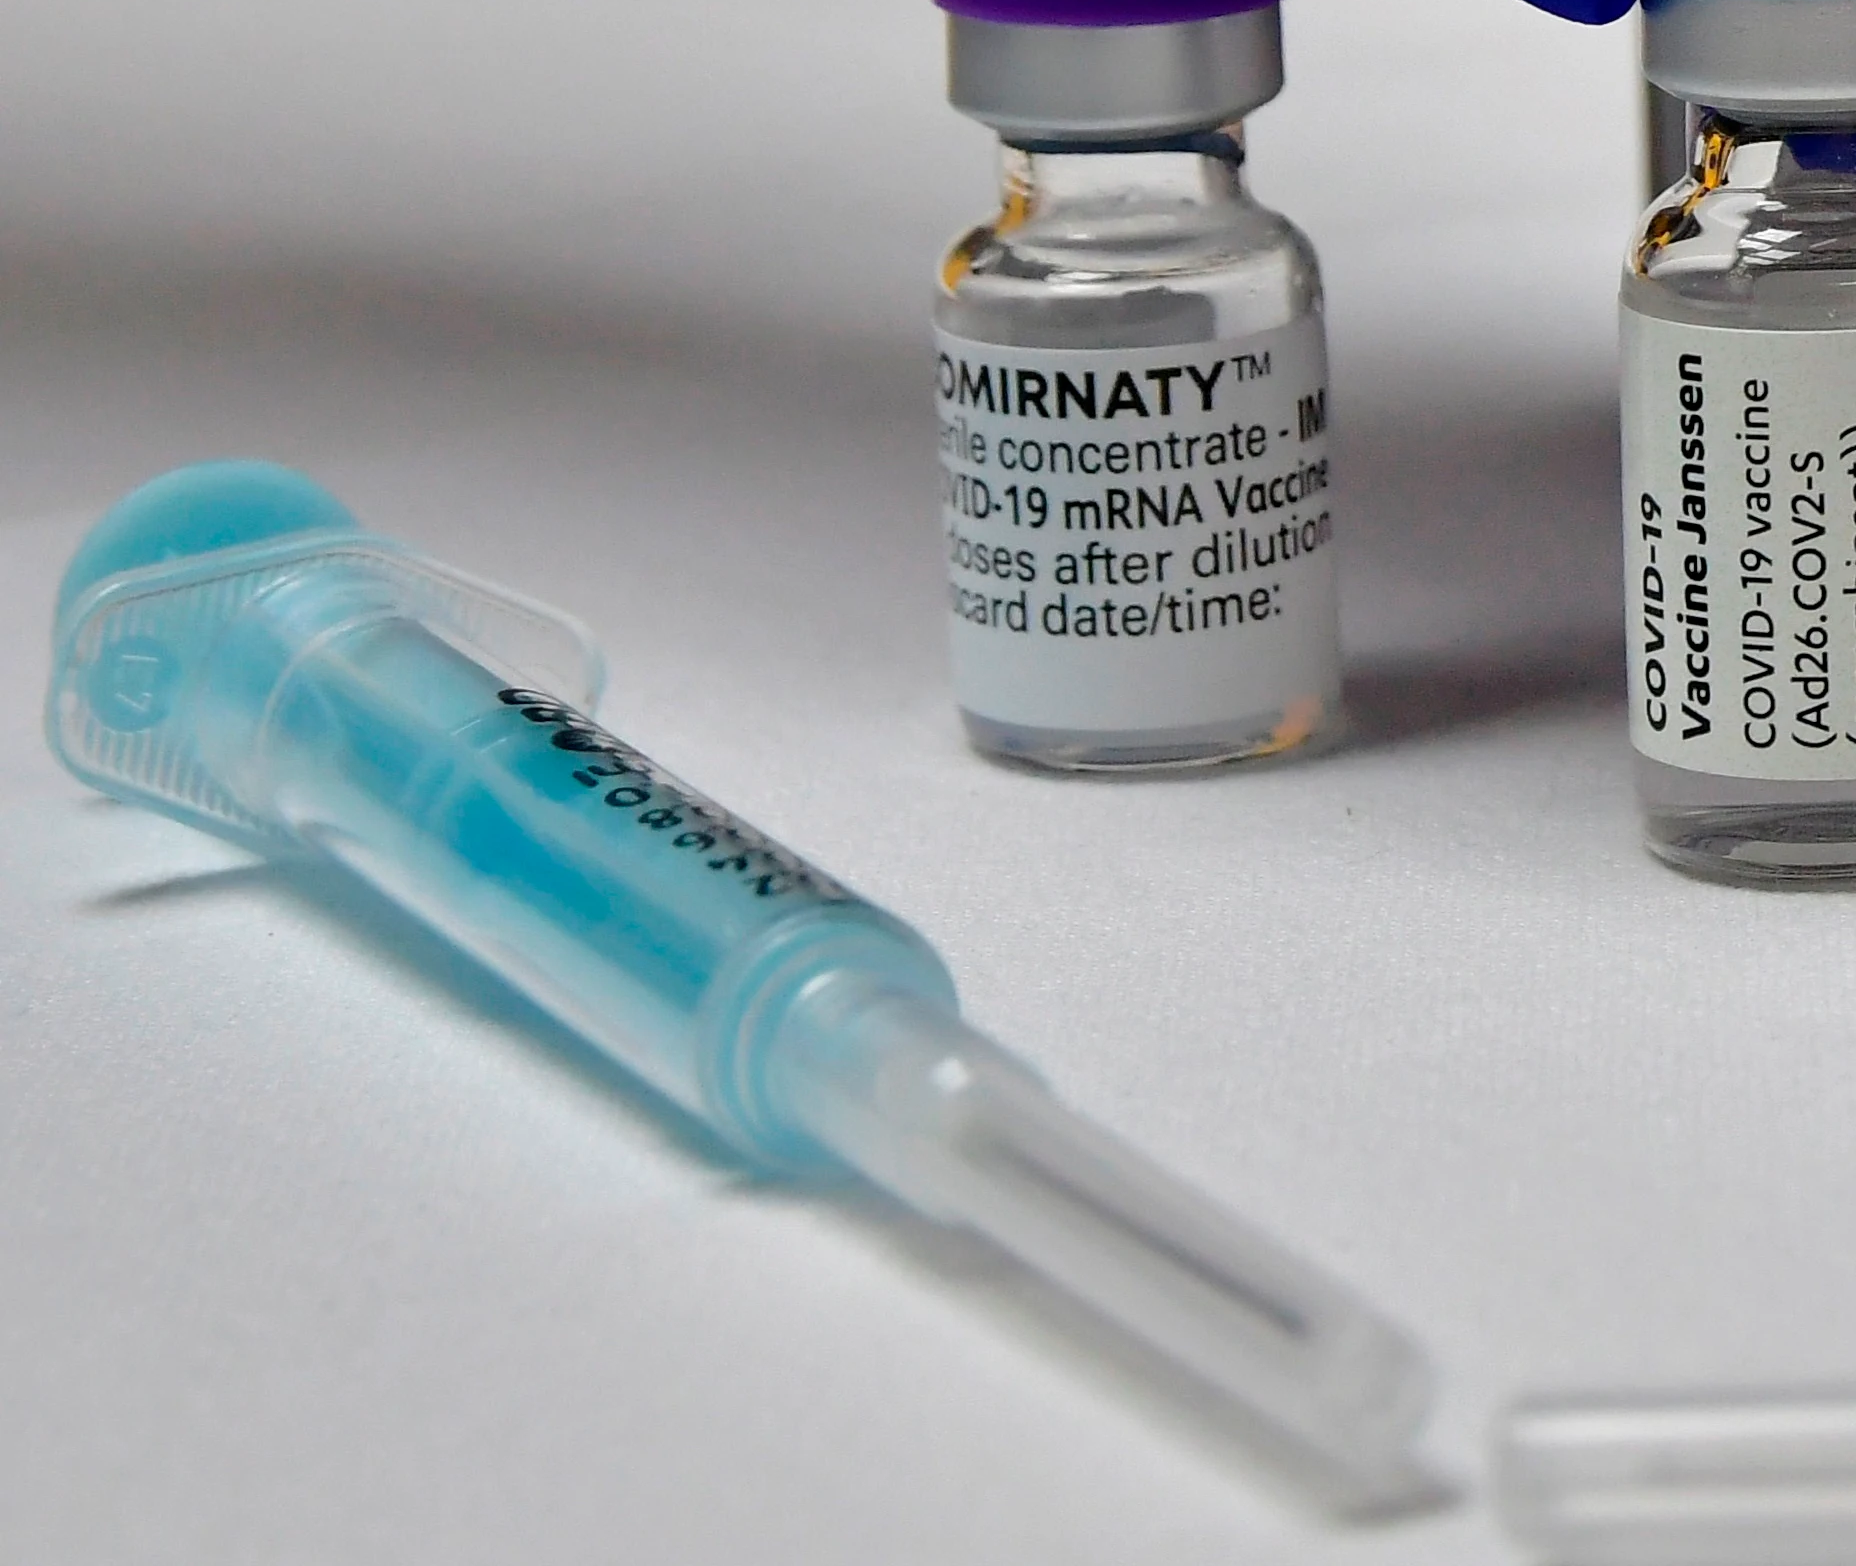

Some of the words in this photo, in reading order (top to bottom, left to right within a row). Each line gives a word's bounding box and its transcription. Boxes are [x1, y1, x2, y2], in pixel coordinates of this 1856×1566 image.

[938, 351, 1272, 421] OMIRNATY™
[999, 421, 1267, 476] concentrate
[1676, 352, 1707, 544] Janssen
[1735, 378, 1772, 537] vaccine
[1054, 541, 1174, 586] after
[1192, 509, 1332, 578] dilution
[1064, 482, 1204, 531] mRNA
[1215, 455, 1329, 518] Vaccine
[1042, 582, 1281, 637] date/time:
[1640, 492, 1667, 732] COVID-19
[1676, 553, 1712, 740] Vaccine
[1739, 547, 1776, 749] COVID-19
[1790, 450, 1838, 749] (Ad26.COV2-S
